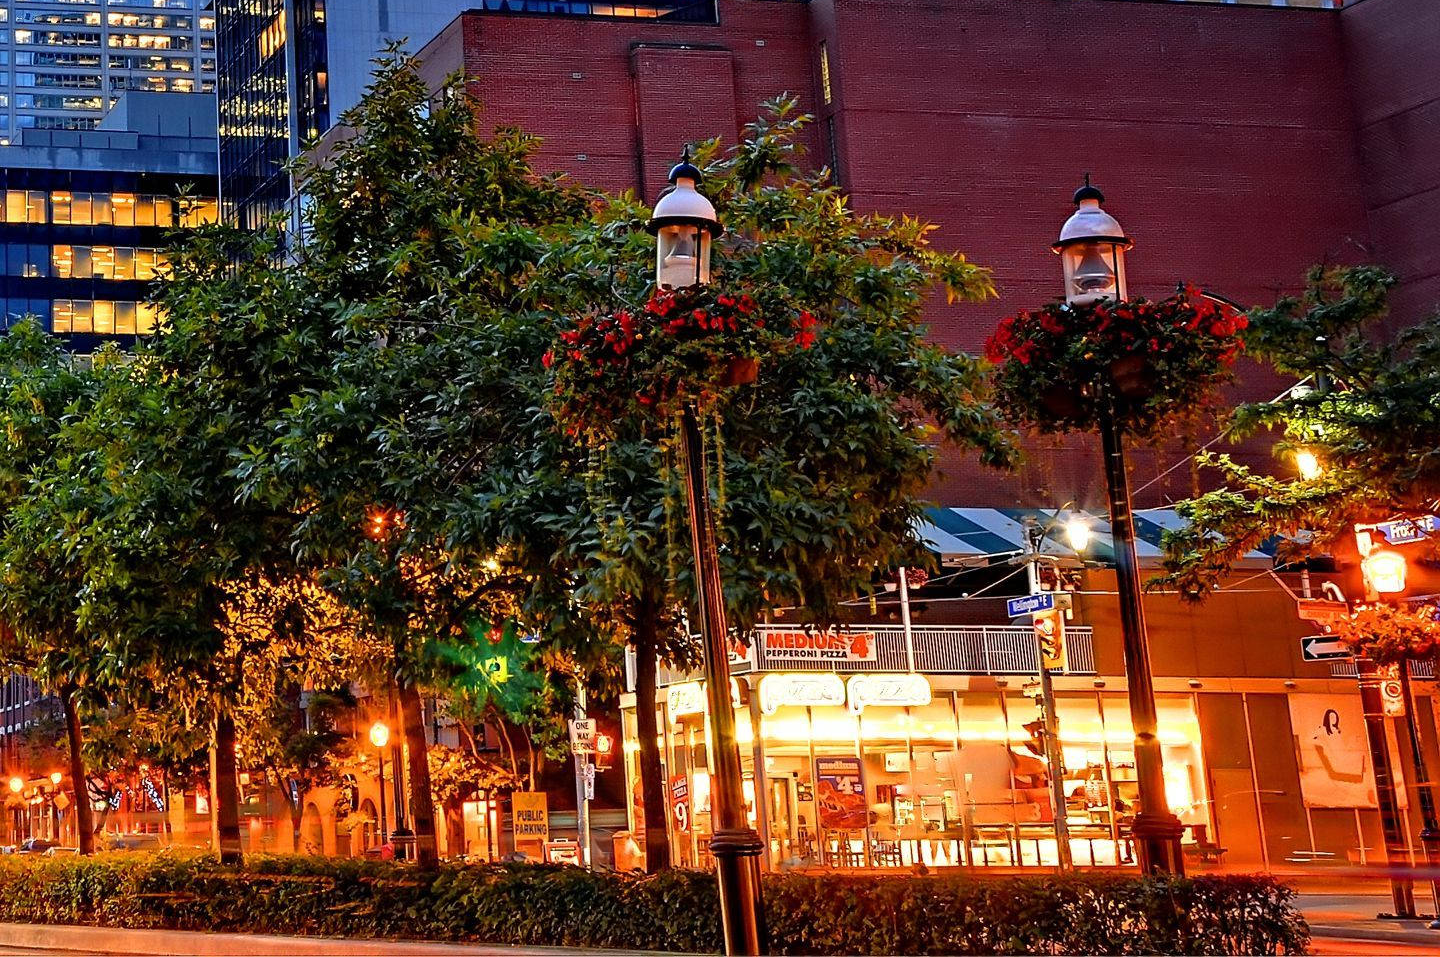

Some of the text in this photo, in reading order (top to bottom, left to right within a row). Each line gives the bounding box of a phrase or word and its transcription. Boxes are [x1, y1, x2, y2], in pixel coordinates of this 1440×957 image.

[1042, 594, 1048, 607] E
[766, 632, 846, 650] MEDIUM
[766, 649, 848, 659] PEPPERONI PIZZA
[575, 722, 589, 730] ONE
[577, 733, 590, 741] WAY
[572, 742, 595, 751] BEGINS
[516, 810, 544, 822] PUBLIC
[515, 824, 548, 835] PARKING
